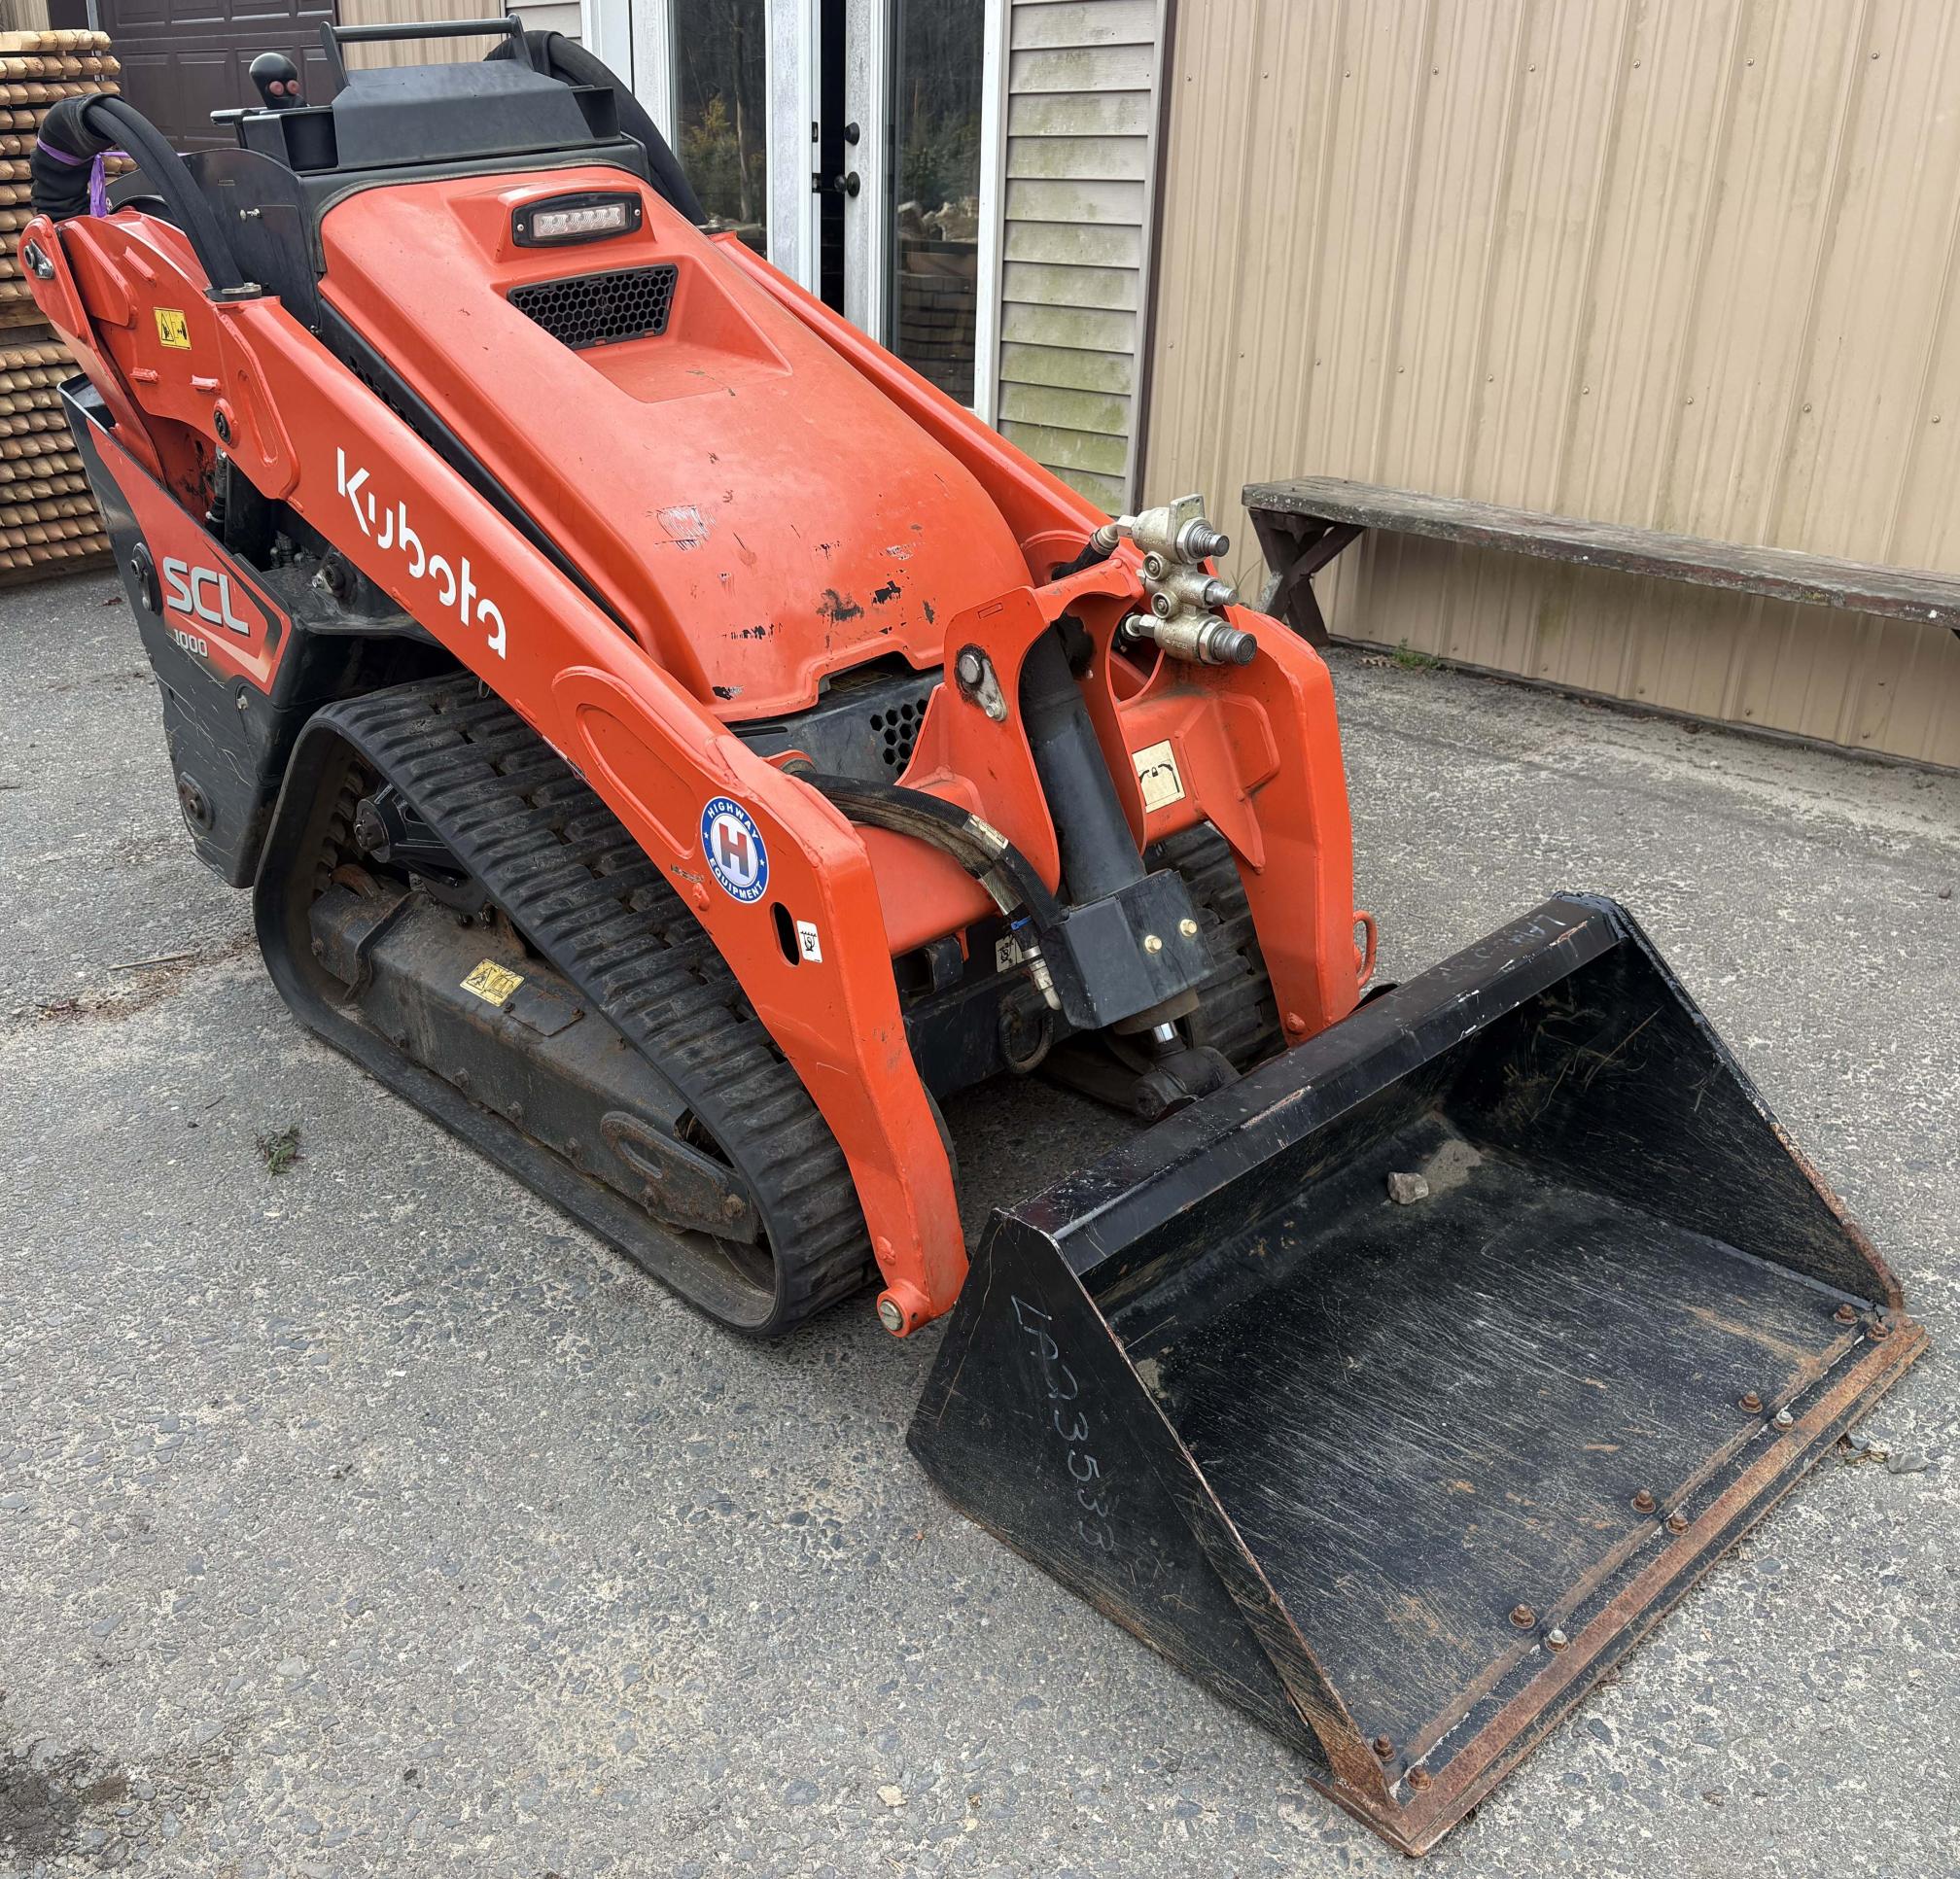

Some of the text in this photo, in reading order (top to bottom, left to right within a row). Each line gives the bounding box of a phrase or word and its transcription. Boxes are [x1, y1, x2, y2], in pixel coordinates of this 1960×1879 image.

[337, 446, 507, 661] Kubota
[163, 556, 250, 637] SCL
[173, 629, 208, 658] 1000
[707, 801, 759, 840] HIGHWAY
[718, 822, 750, 879] H
[709, 857, 763, 900] EQUIPMENT
